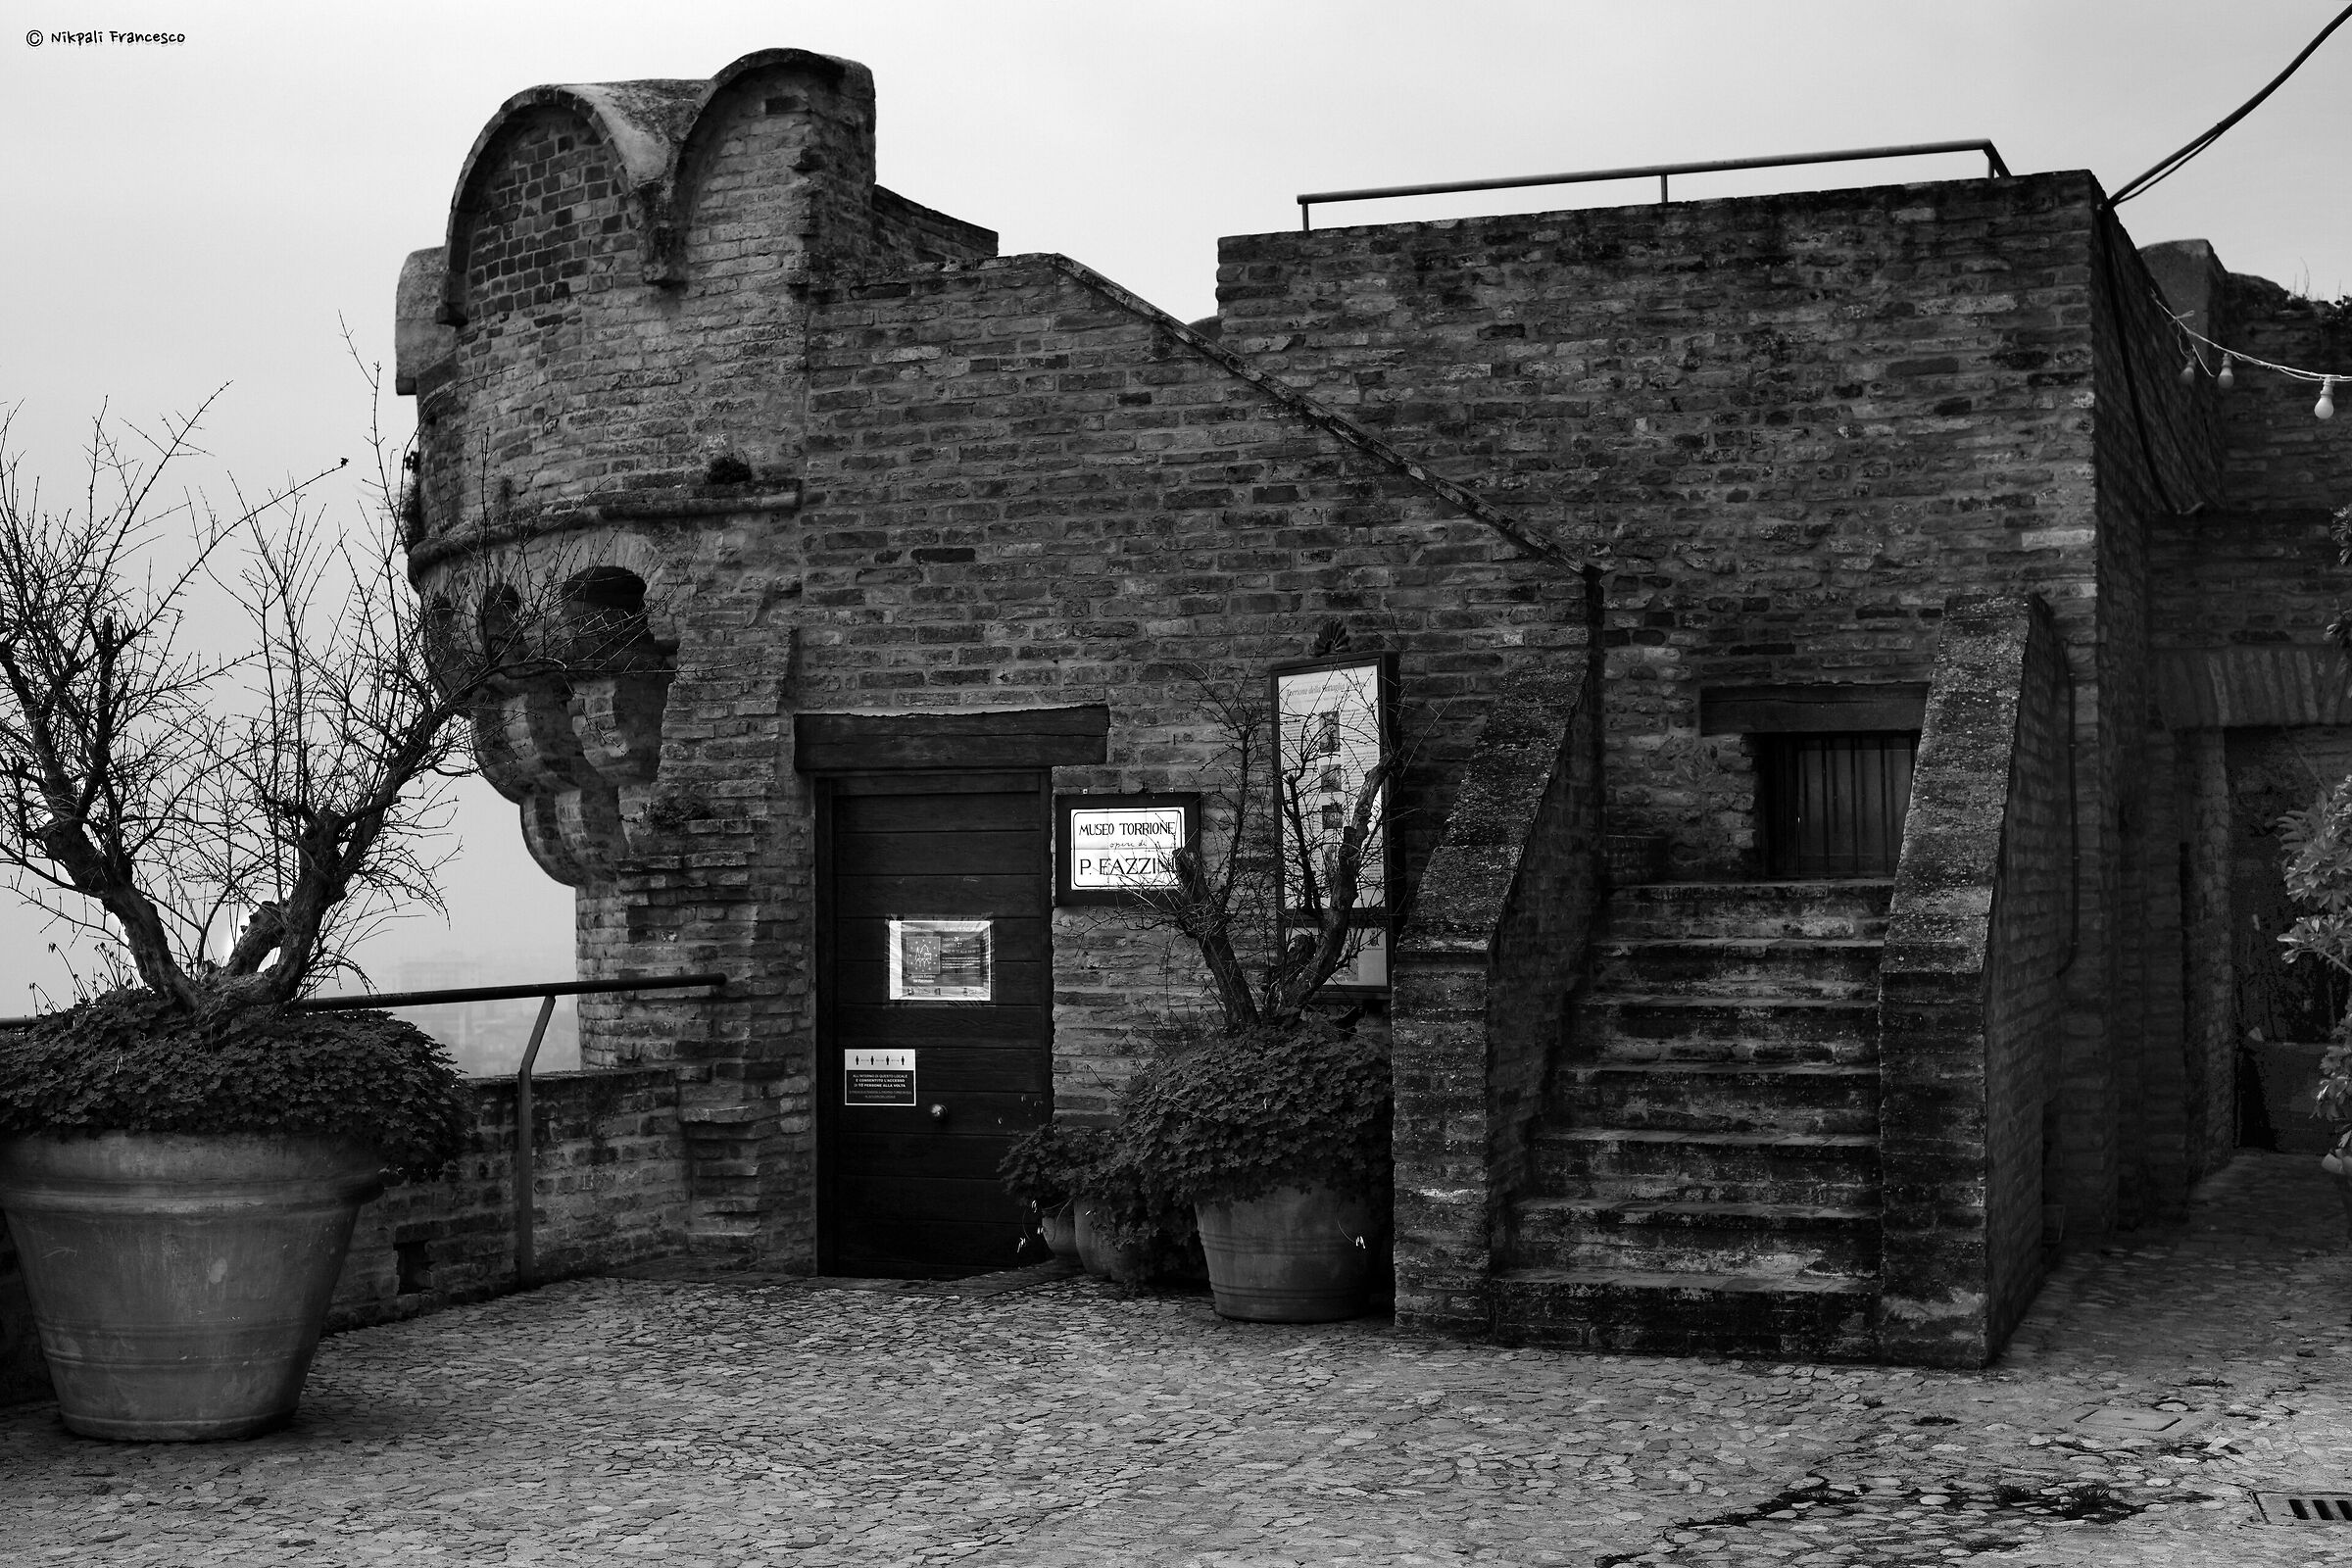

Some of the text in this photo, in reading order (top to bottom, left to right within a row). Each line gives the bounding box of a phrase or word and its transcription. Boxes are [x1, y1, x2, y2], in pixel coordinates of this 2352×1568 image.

[1079, 822, 1176, 836] MUSEO TORRIONE
[1080, 858, 1092, 875] P.
